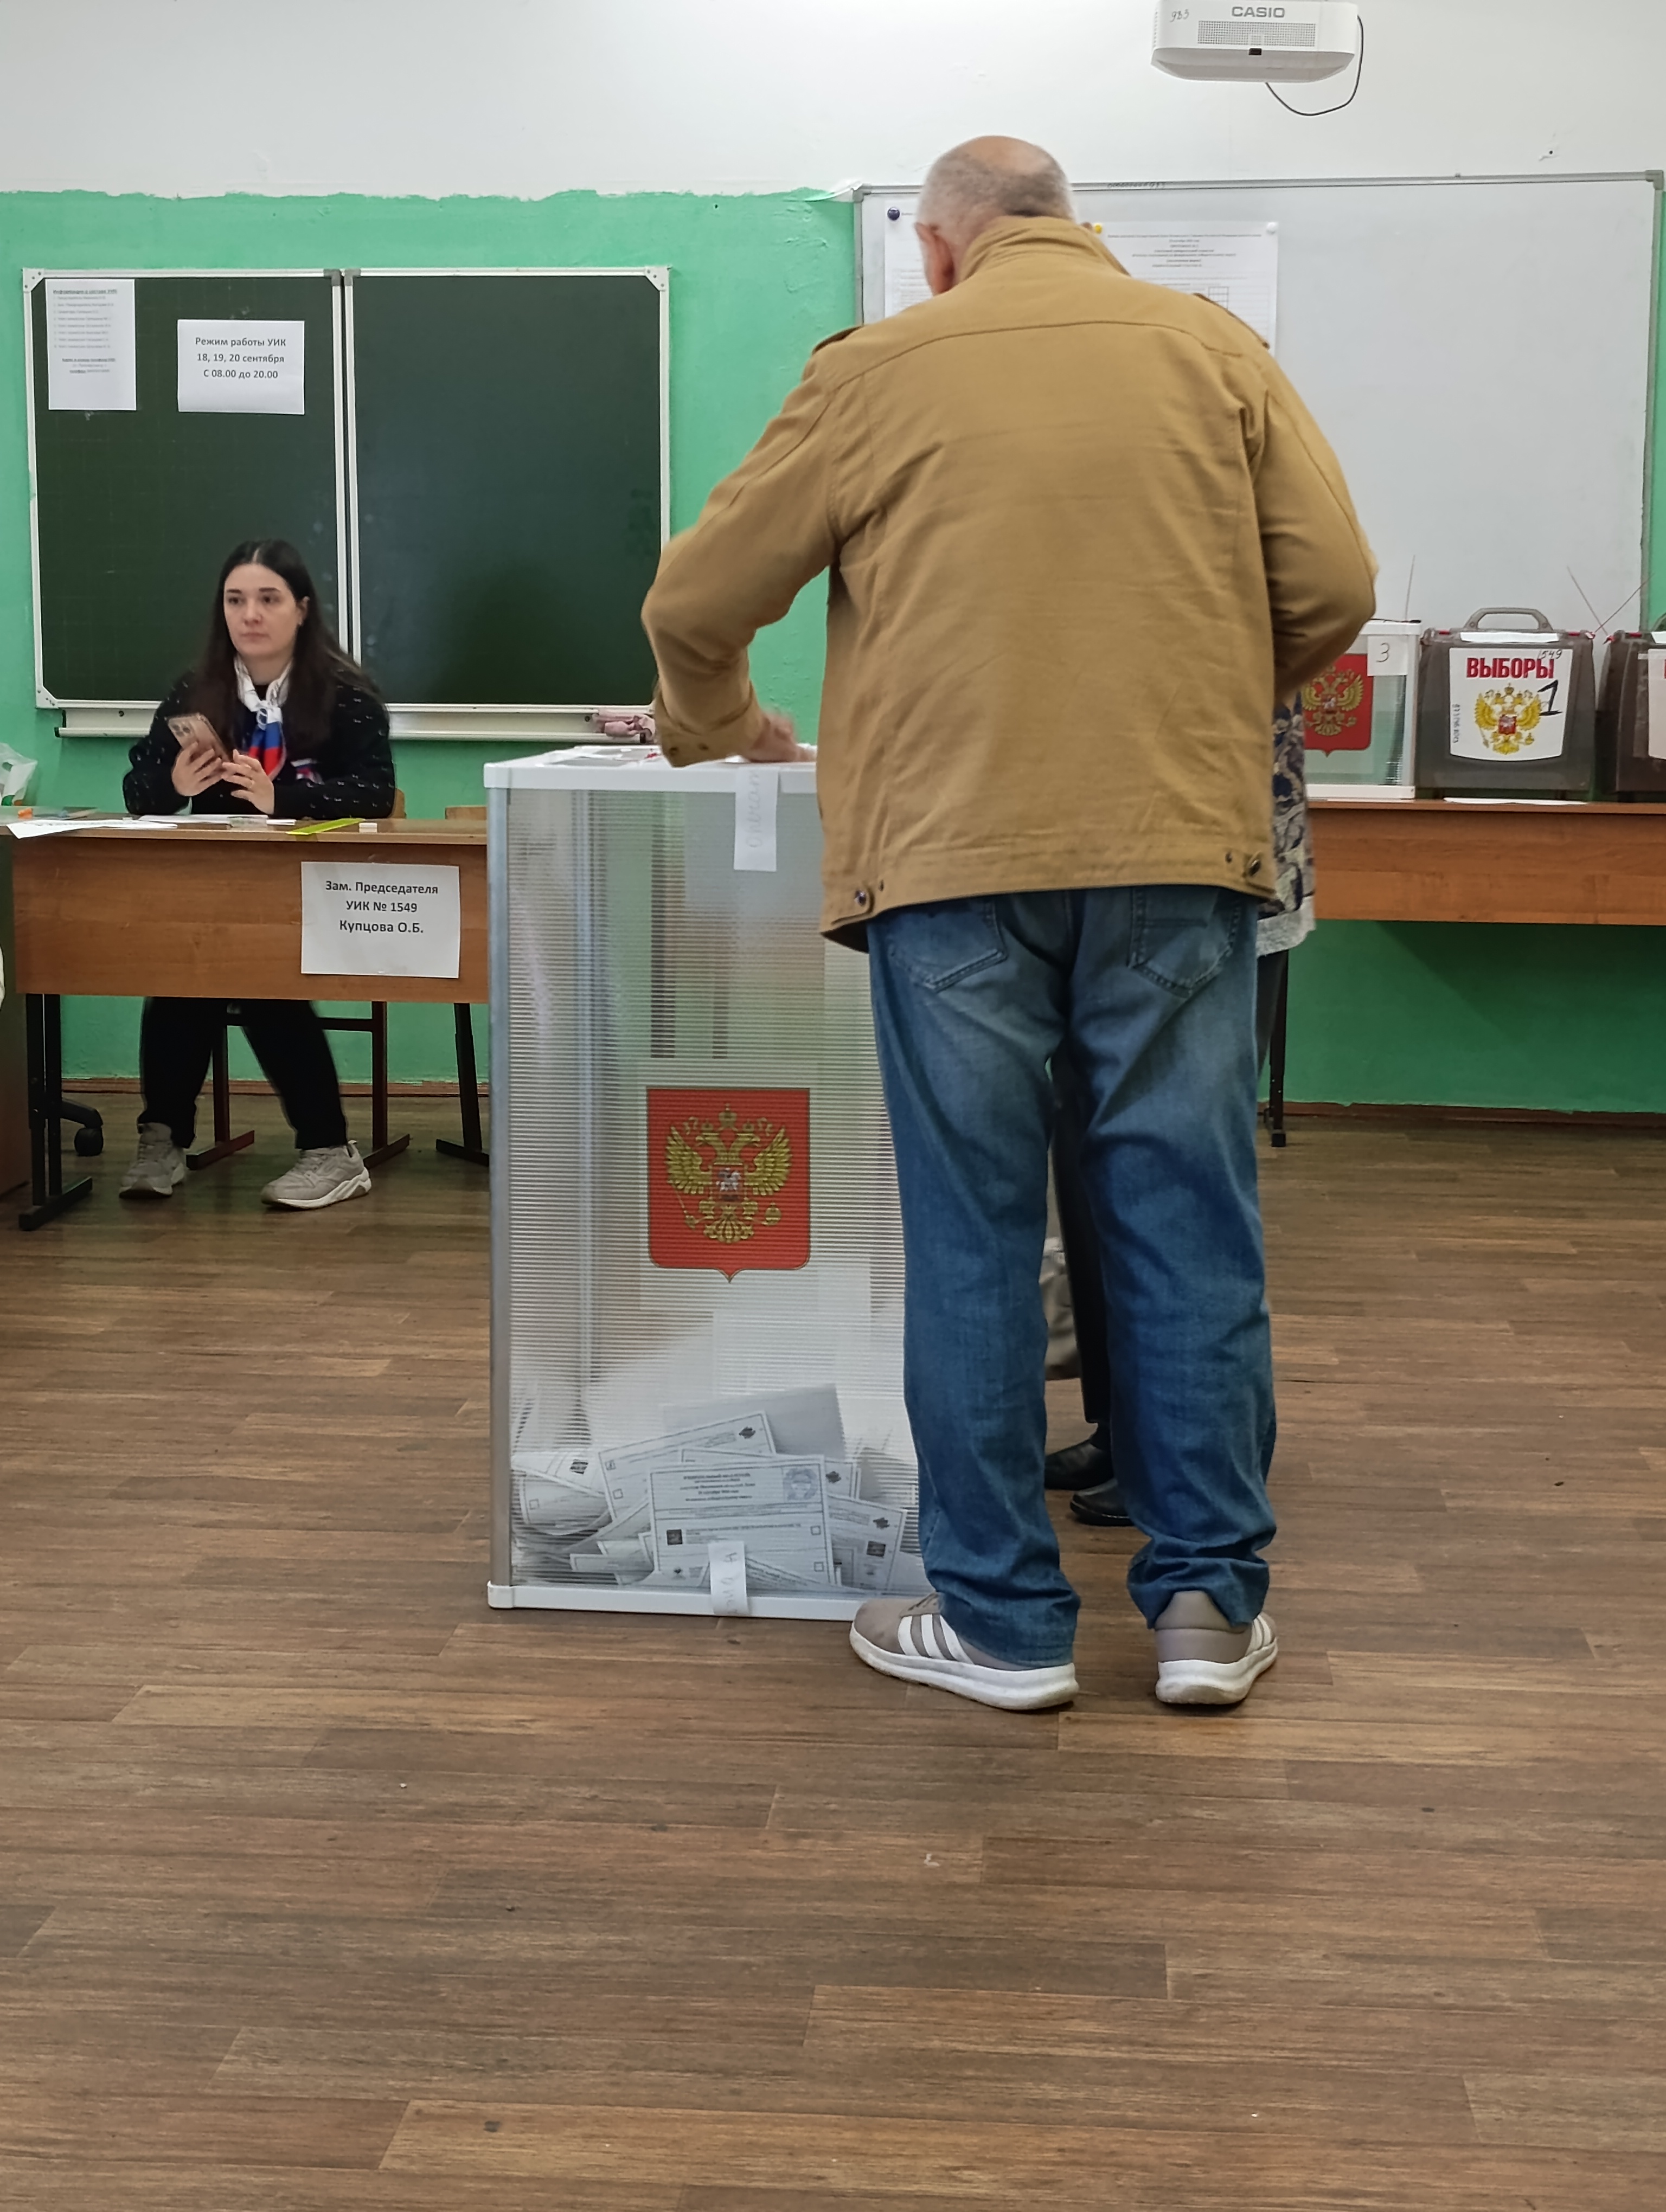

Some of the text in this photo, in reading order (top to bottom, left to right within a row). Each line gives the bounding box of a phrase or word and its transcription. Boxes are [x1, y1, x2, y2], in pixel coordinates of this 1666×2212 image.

[1232, 6, 1285, 18] CASIO
[195, 337, 286, 348] Режим работы УИК
[197, 353, 284, 364] 18, 19, 20 сентября
[203, 369, 278, 380] С 08.00 до 20.00
[1376, 642, 1390, 663] 3
[1466, 657, 1555, 679] ВЫБОРЫ
[1537, 679, 1563, 716] 1
[325, 880, 438, 895] Зам. Председателя
[346, 901, 417, 913] УИК № 1549
[339, 919, 424, 934] Купцова О.Б.
